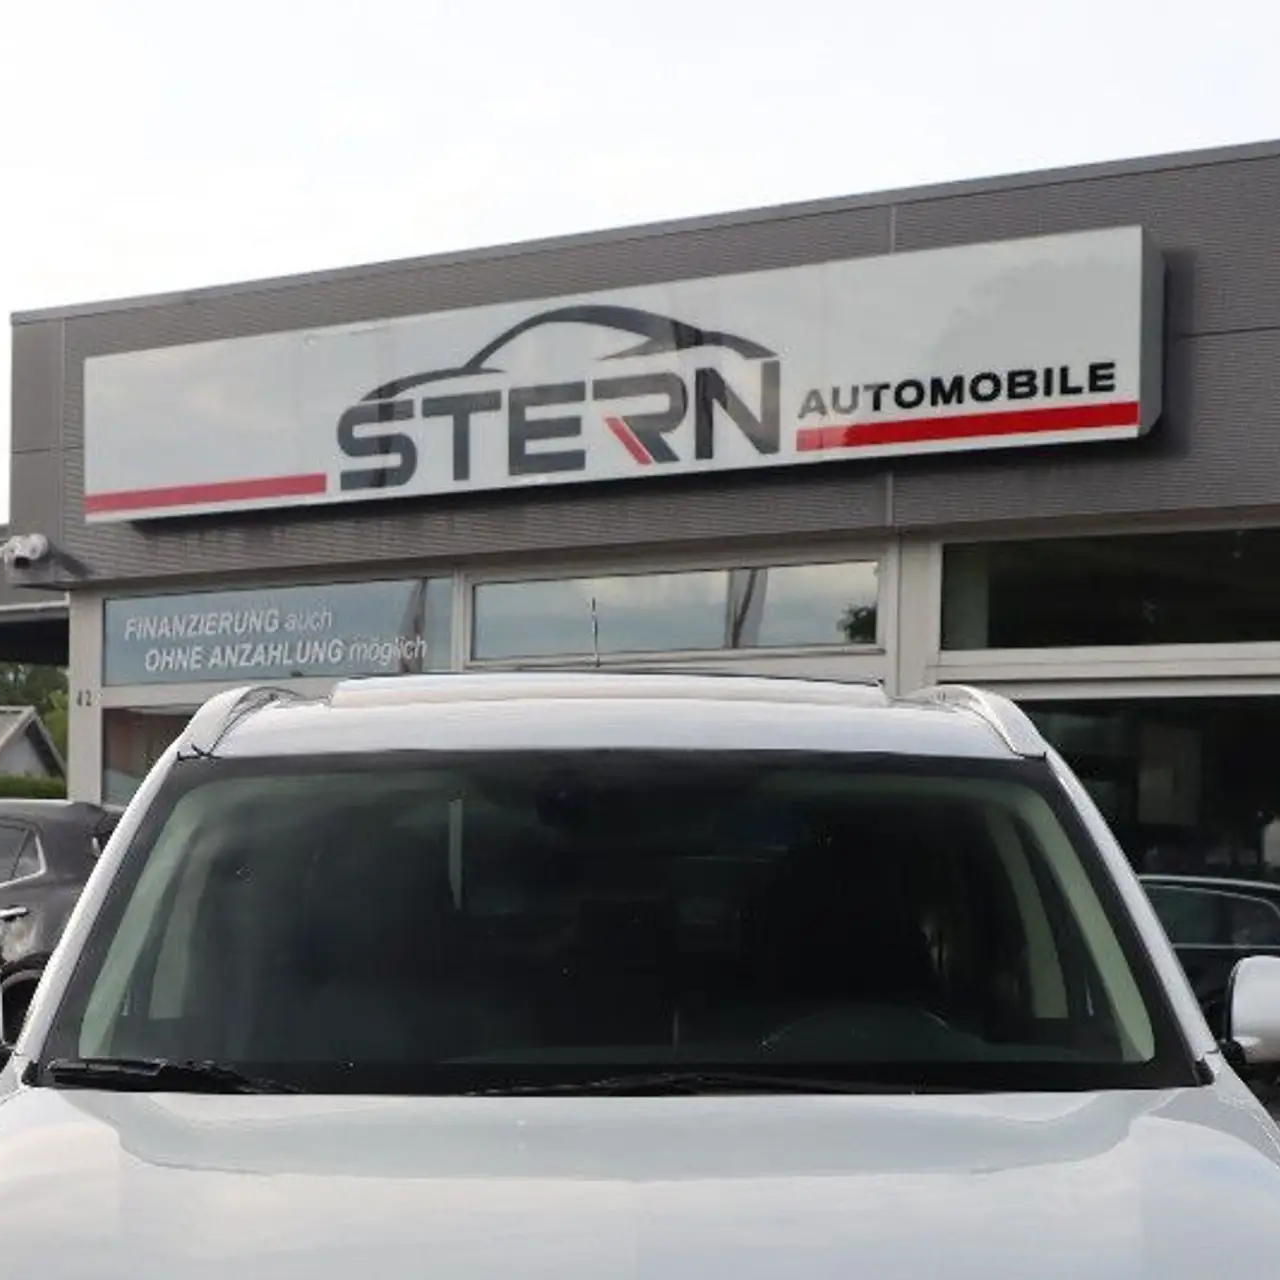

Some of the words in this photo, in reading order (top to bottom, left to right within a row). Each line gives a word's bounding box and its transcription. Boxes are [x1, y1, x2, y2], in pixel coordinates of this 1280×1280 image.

[337, 360, 781, 490] STERN
[797, 362, 1116, 419] AUTOMOBILE
[124, 609, 280, 640] FINANZIERUNG
[284, 609, 332, 633] auch
[144, 646, 204, 672] OHNE
[207, 638, 344, 668] ANZAHLUNG
[348, 636, 428, 666] möglich
